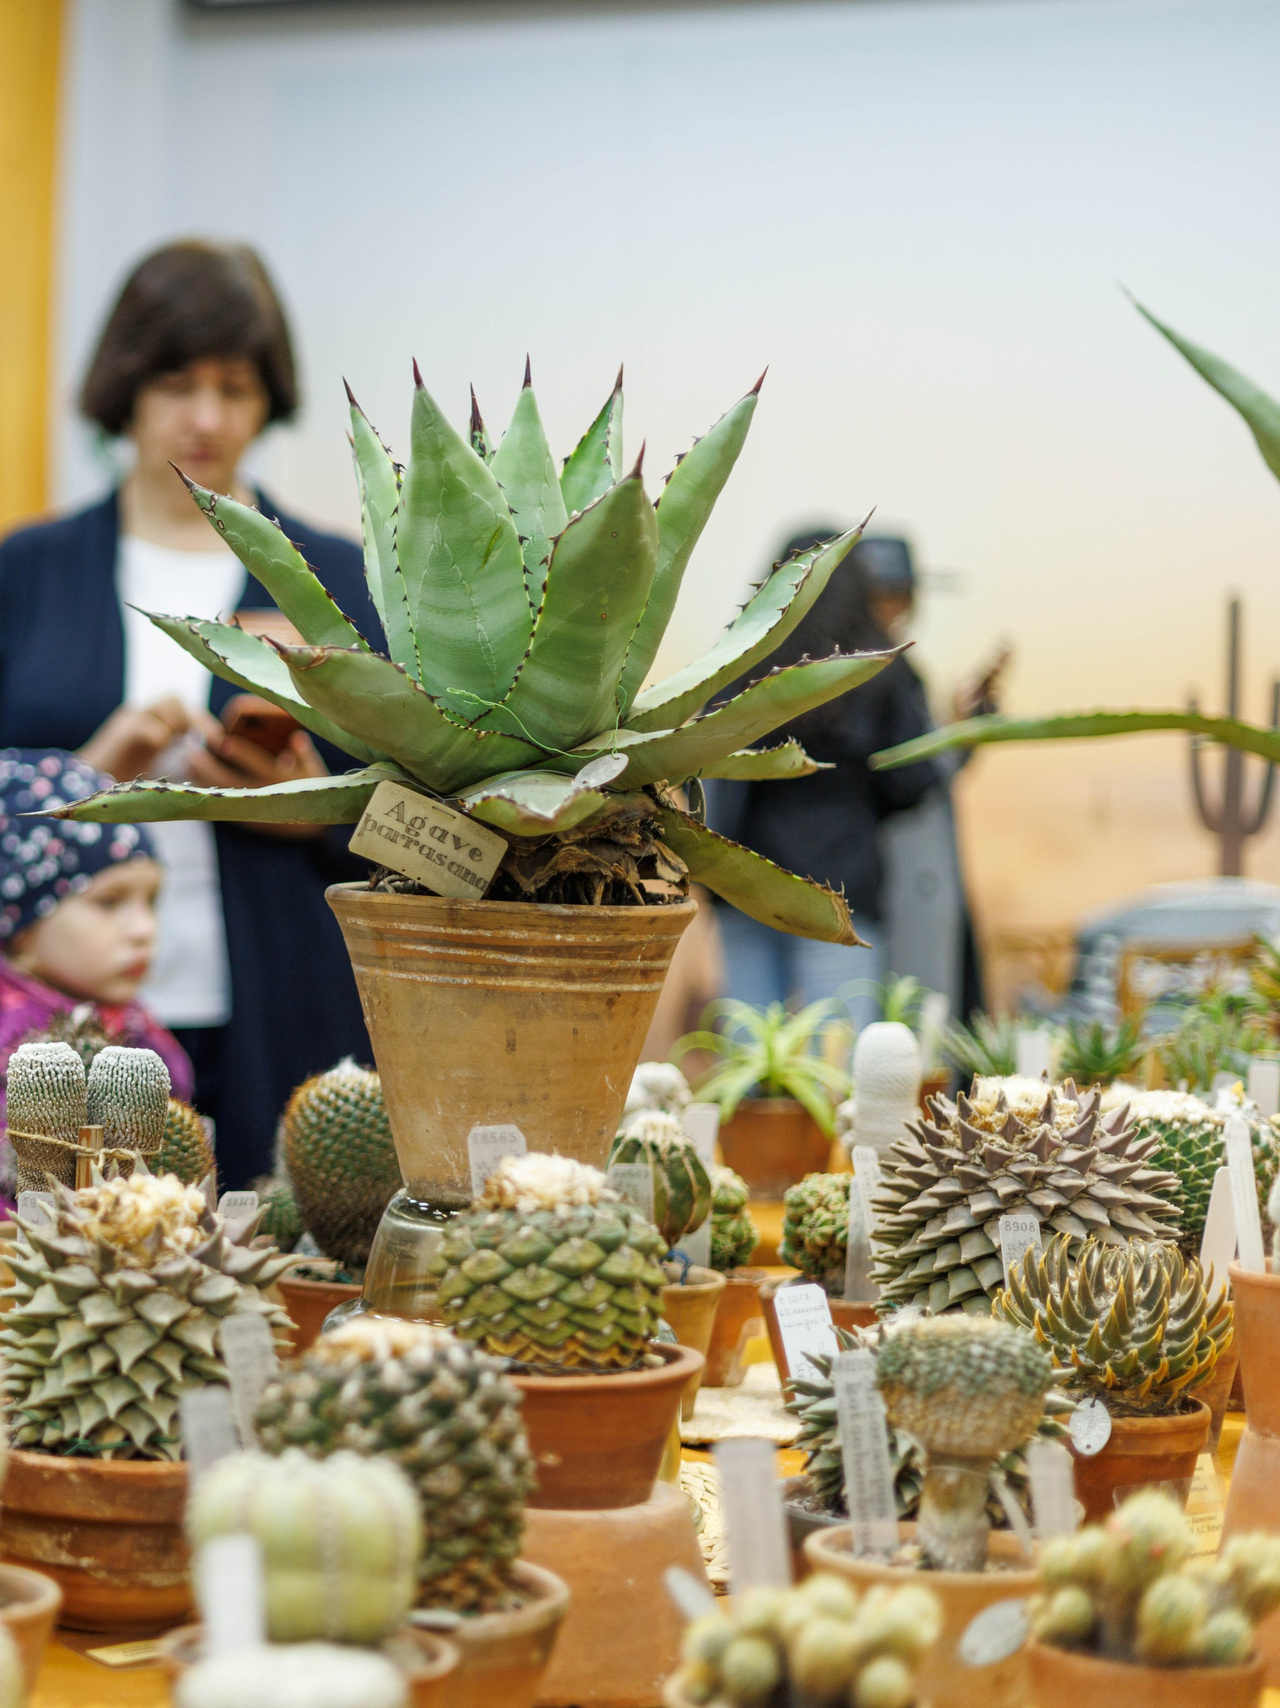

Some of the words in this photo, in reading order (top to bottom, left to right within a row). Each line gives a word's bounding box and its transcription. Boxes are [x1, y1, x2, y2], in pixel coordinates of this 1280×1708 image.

[357, 813, 490, 892] parrasana
[384, 800, 483, 862] Agave
[1005, 1220, 1035, 1232] 8908
